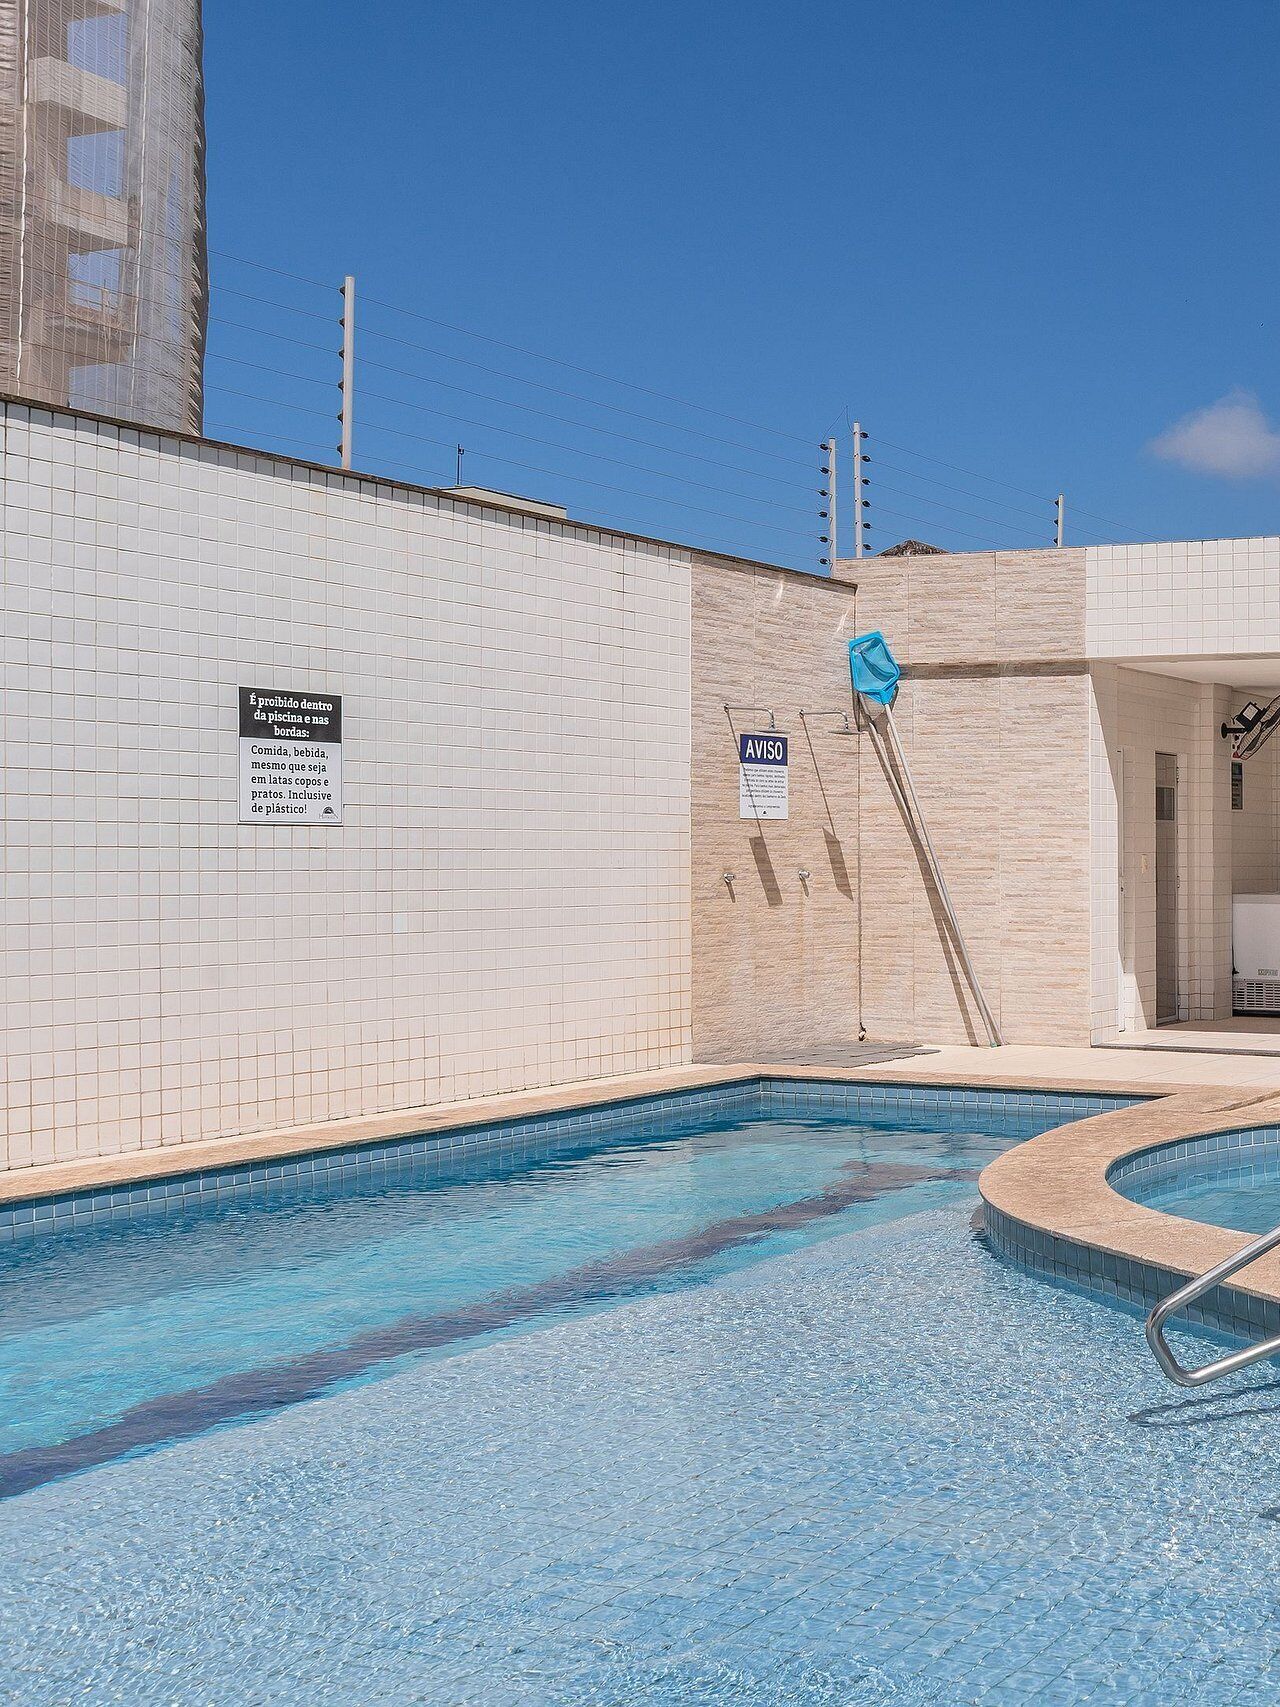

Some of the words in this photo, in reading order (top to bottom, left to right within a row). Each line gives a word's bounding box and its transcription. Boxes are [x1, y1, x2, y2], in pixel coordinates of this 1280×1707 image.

[249, 692, 256, 705] É
[258, 696, 299, 708] proibido
[300, 699, 333, 712] dentro
[254, 709, 266, 720] da
[268, 711, 304, 724] piscina
[312, 716, 330, 725] nas
[274, 725, 310, 738] bordas:
[251, 745, 292, 758] Comida,
[294, 747, 329, 760] bebida,
[746, 740, 782, 760] AVISO
[251, 762, 286, 770] mesmo
[288, 763, 306, 774] que
[308, 762, 326, 774] seja
[251, 776, 266, 784] em
[268, 774, 292, 785] latas
[294, 778, 322, 788] copos
[251, 790, 286, 800] pratos.
[288, 790, 332, 800] Inclusive
[252, 803, 264, 813] de
[266, 803, 307, 816] plástico!
